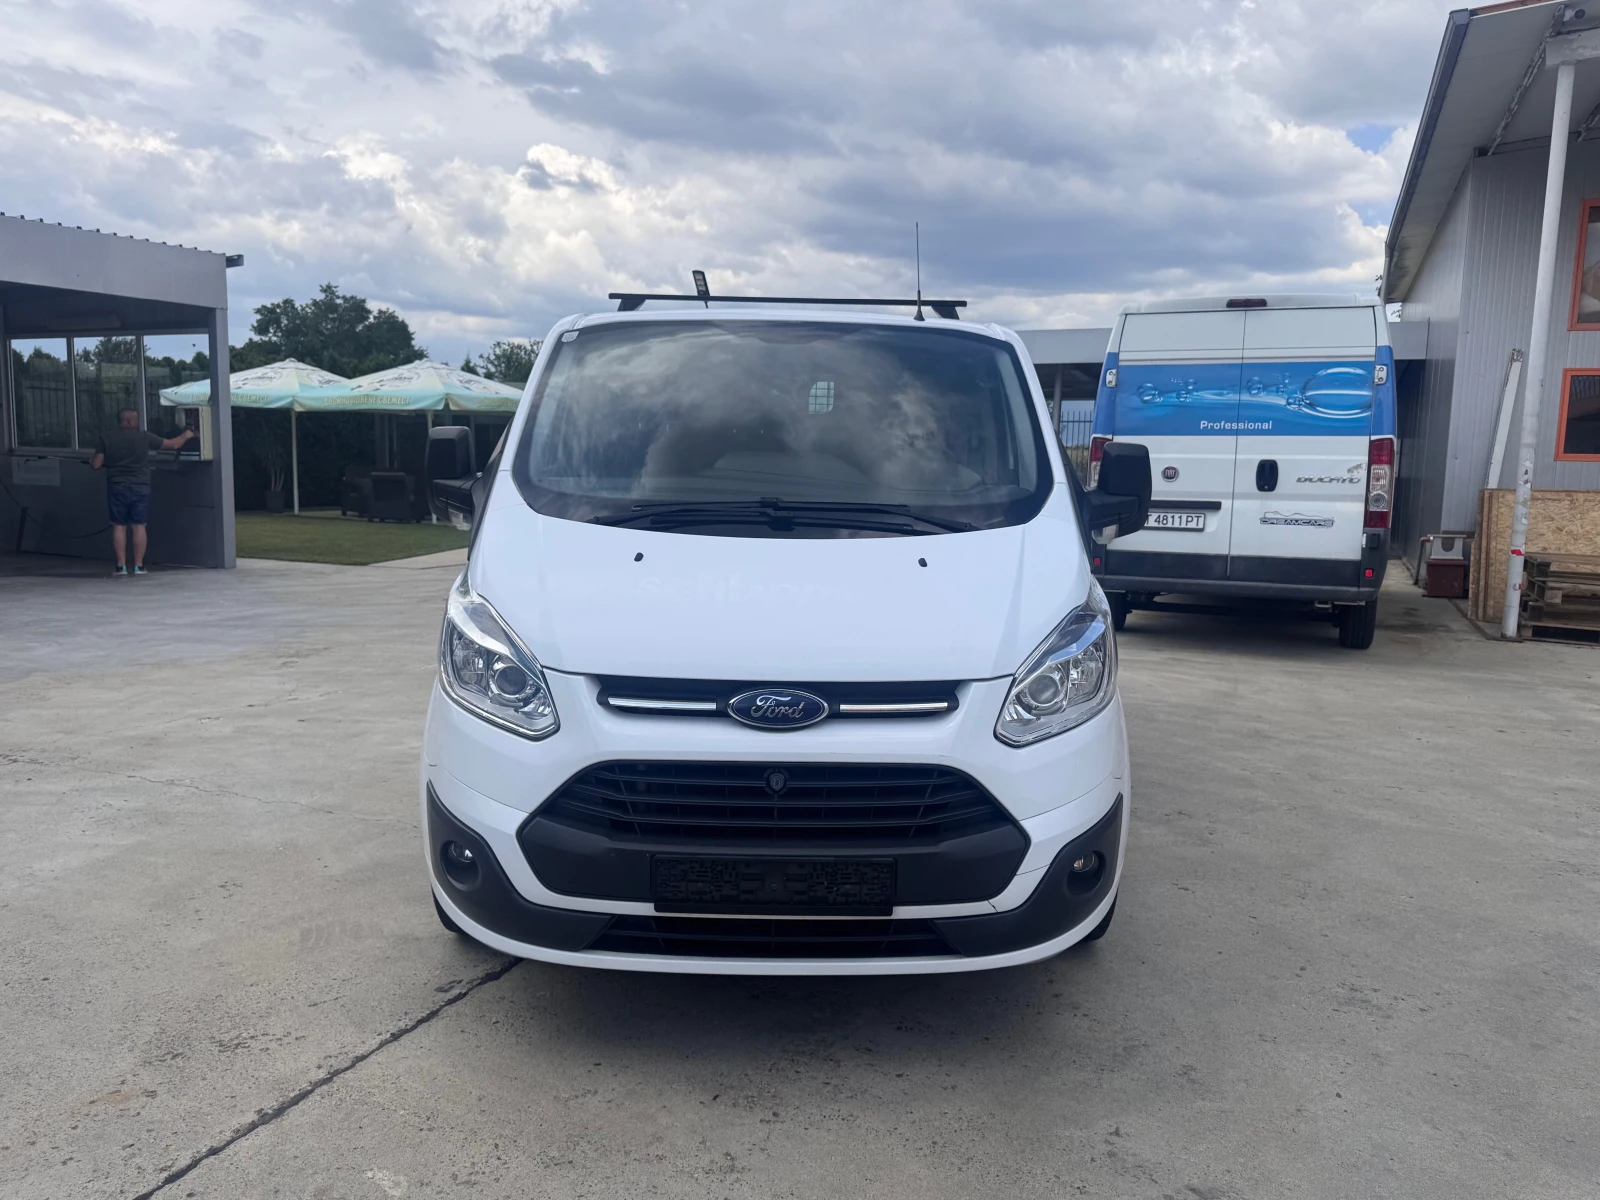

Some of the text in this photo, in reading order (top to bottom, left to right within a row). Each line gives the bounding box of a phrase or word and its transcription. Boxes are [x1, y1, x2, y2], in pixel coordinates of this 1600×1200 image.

[1200, 420, 1272, 430] Professional
[1296, 476, 1360, 484] DUCATO
[750, 694, 804, 718] Ford
